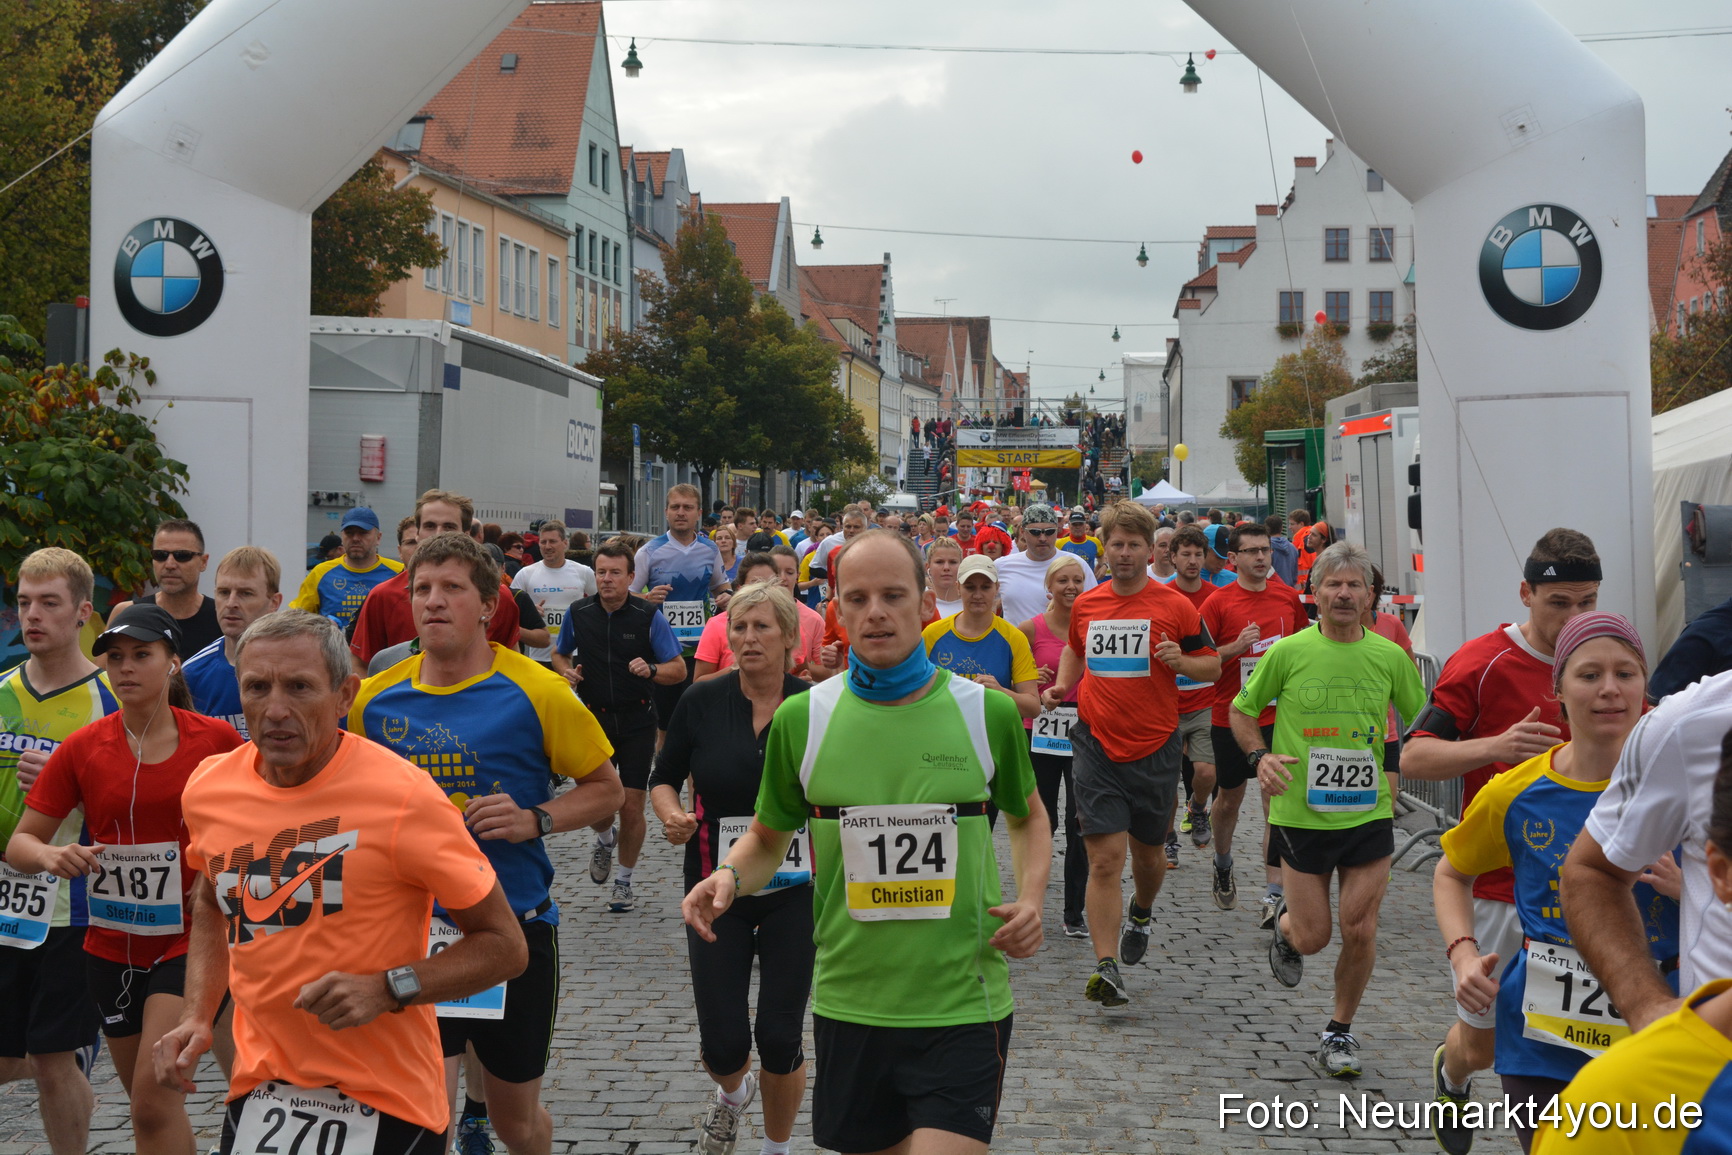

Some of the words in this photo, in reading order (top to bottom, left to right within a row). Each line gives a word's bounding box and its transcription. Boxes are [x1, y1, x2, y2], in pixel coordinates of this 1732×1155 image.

[1488, 207, 1593, 250] BMW
[121, 220, 215, 260] BMW
[566, 419, 595, 462] BOCK
[997, 453, 1040, 463] START
[668, 611, 702, 626] 2125
[1092, 633, 1144, 655] 3417
[922, 752, 968, 763] Quellenhof
[1310, 752, 1335, 761] PARTL
[457, 780, 477, 788] 2014
[1315, 763, 1374, 788] 2423
[1324, 793, 1362, 804] Michael
[842, 817, 885, 829] PARTL
[887, 815, 947, 827] Neumarkt
[1529, 831, 1548, 839] Jahre
[868, 832, 946, 875] 124
[3, 868, 43, 882] Neumarkt
[92, 865, 170, 900] 2187
[871, 886, 944, 904] Christian
[106, 904, 156, 923] Stefanie
[1531, 952, 1573, 970] PARTL
[1564, 1025, 1611, 1047] Anika
[290, 1097, 355, 1115] Neumarkt
[255, 1107, 348, 1155] 270
